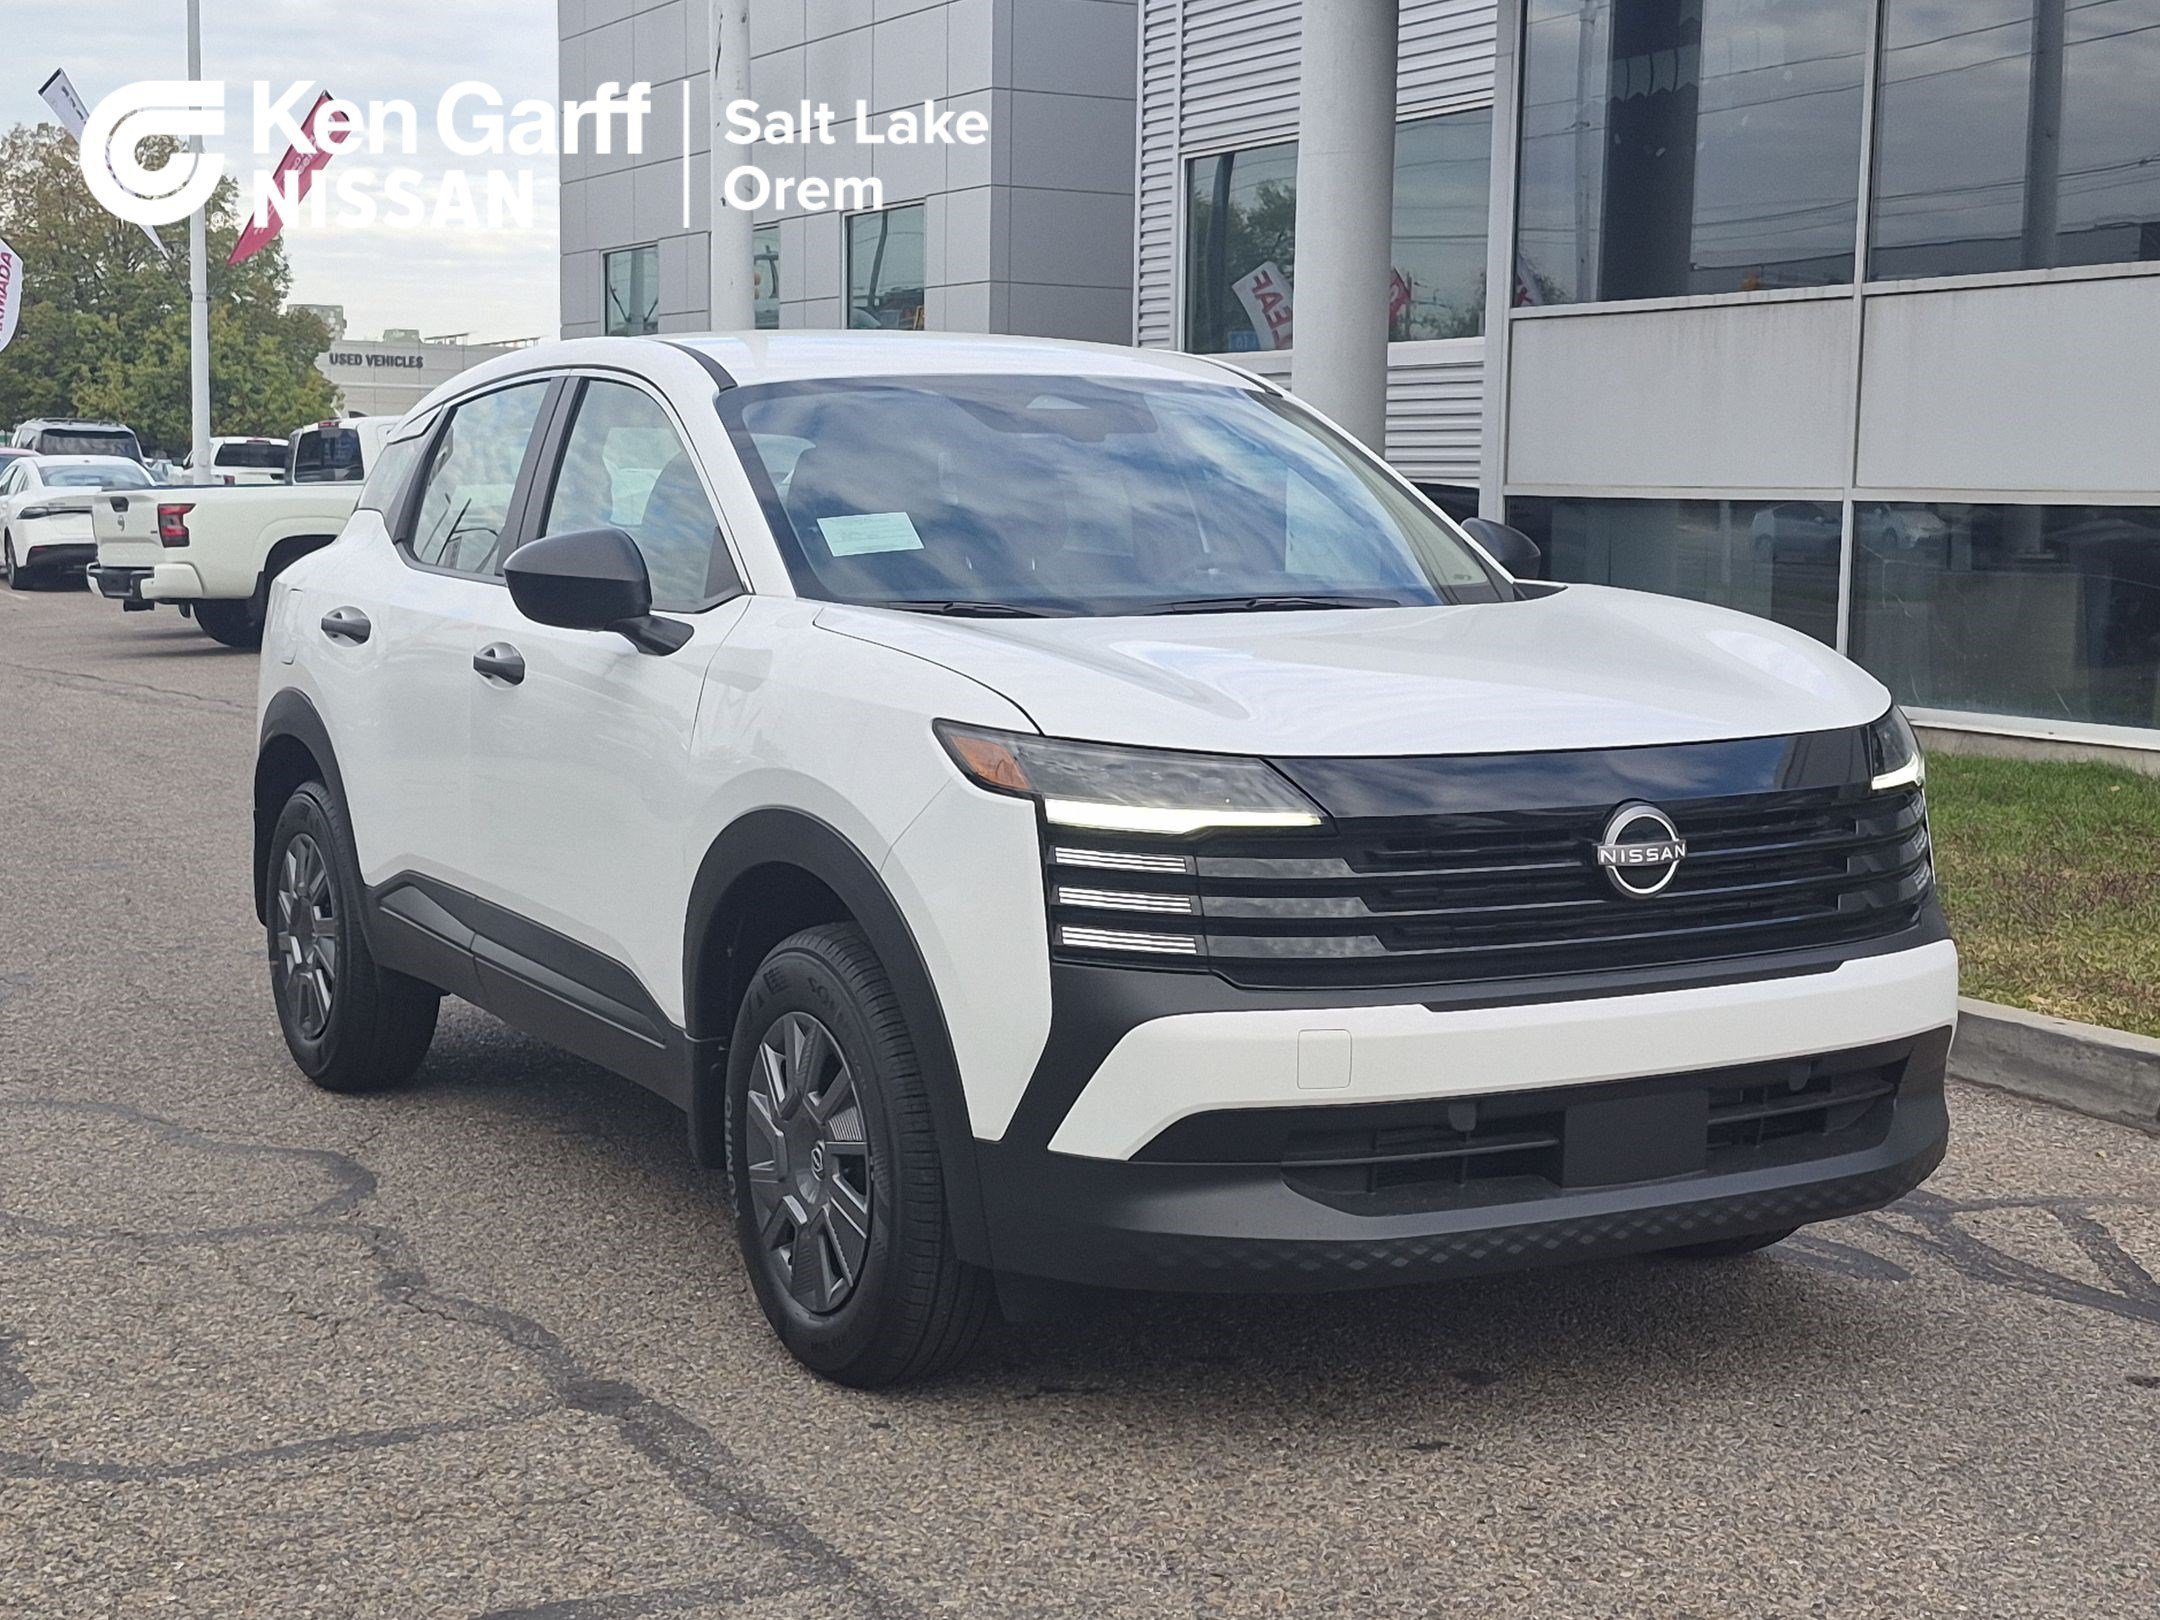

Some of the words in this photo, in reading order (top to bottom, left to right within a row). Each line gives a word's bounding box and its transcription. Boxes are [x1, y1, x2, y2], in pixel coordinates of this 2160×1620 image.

[328, 352, 363, 366] USED
[365, 354, 424, 369] VEHICLES
[1600, 843, 1686, 863] NISSAN
